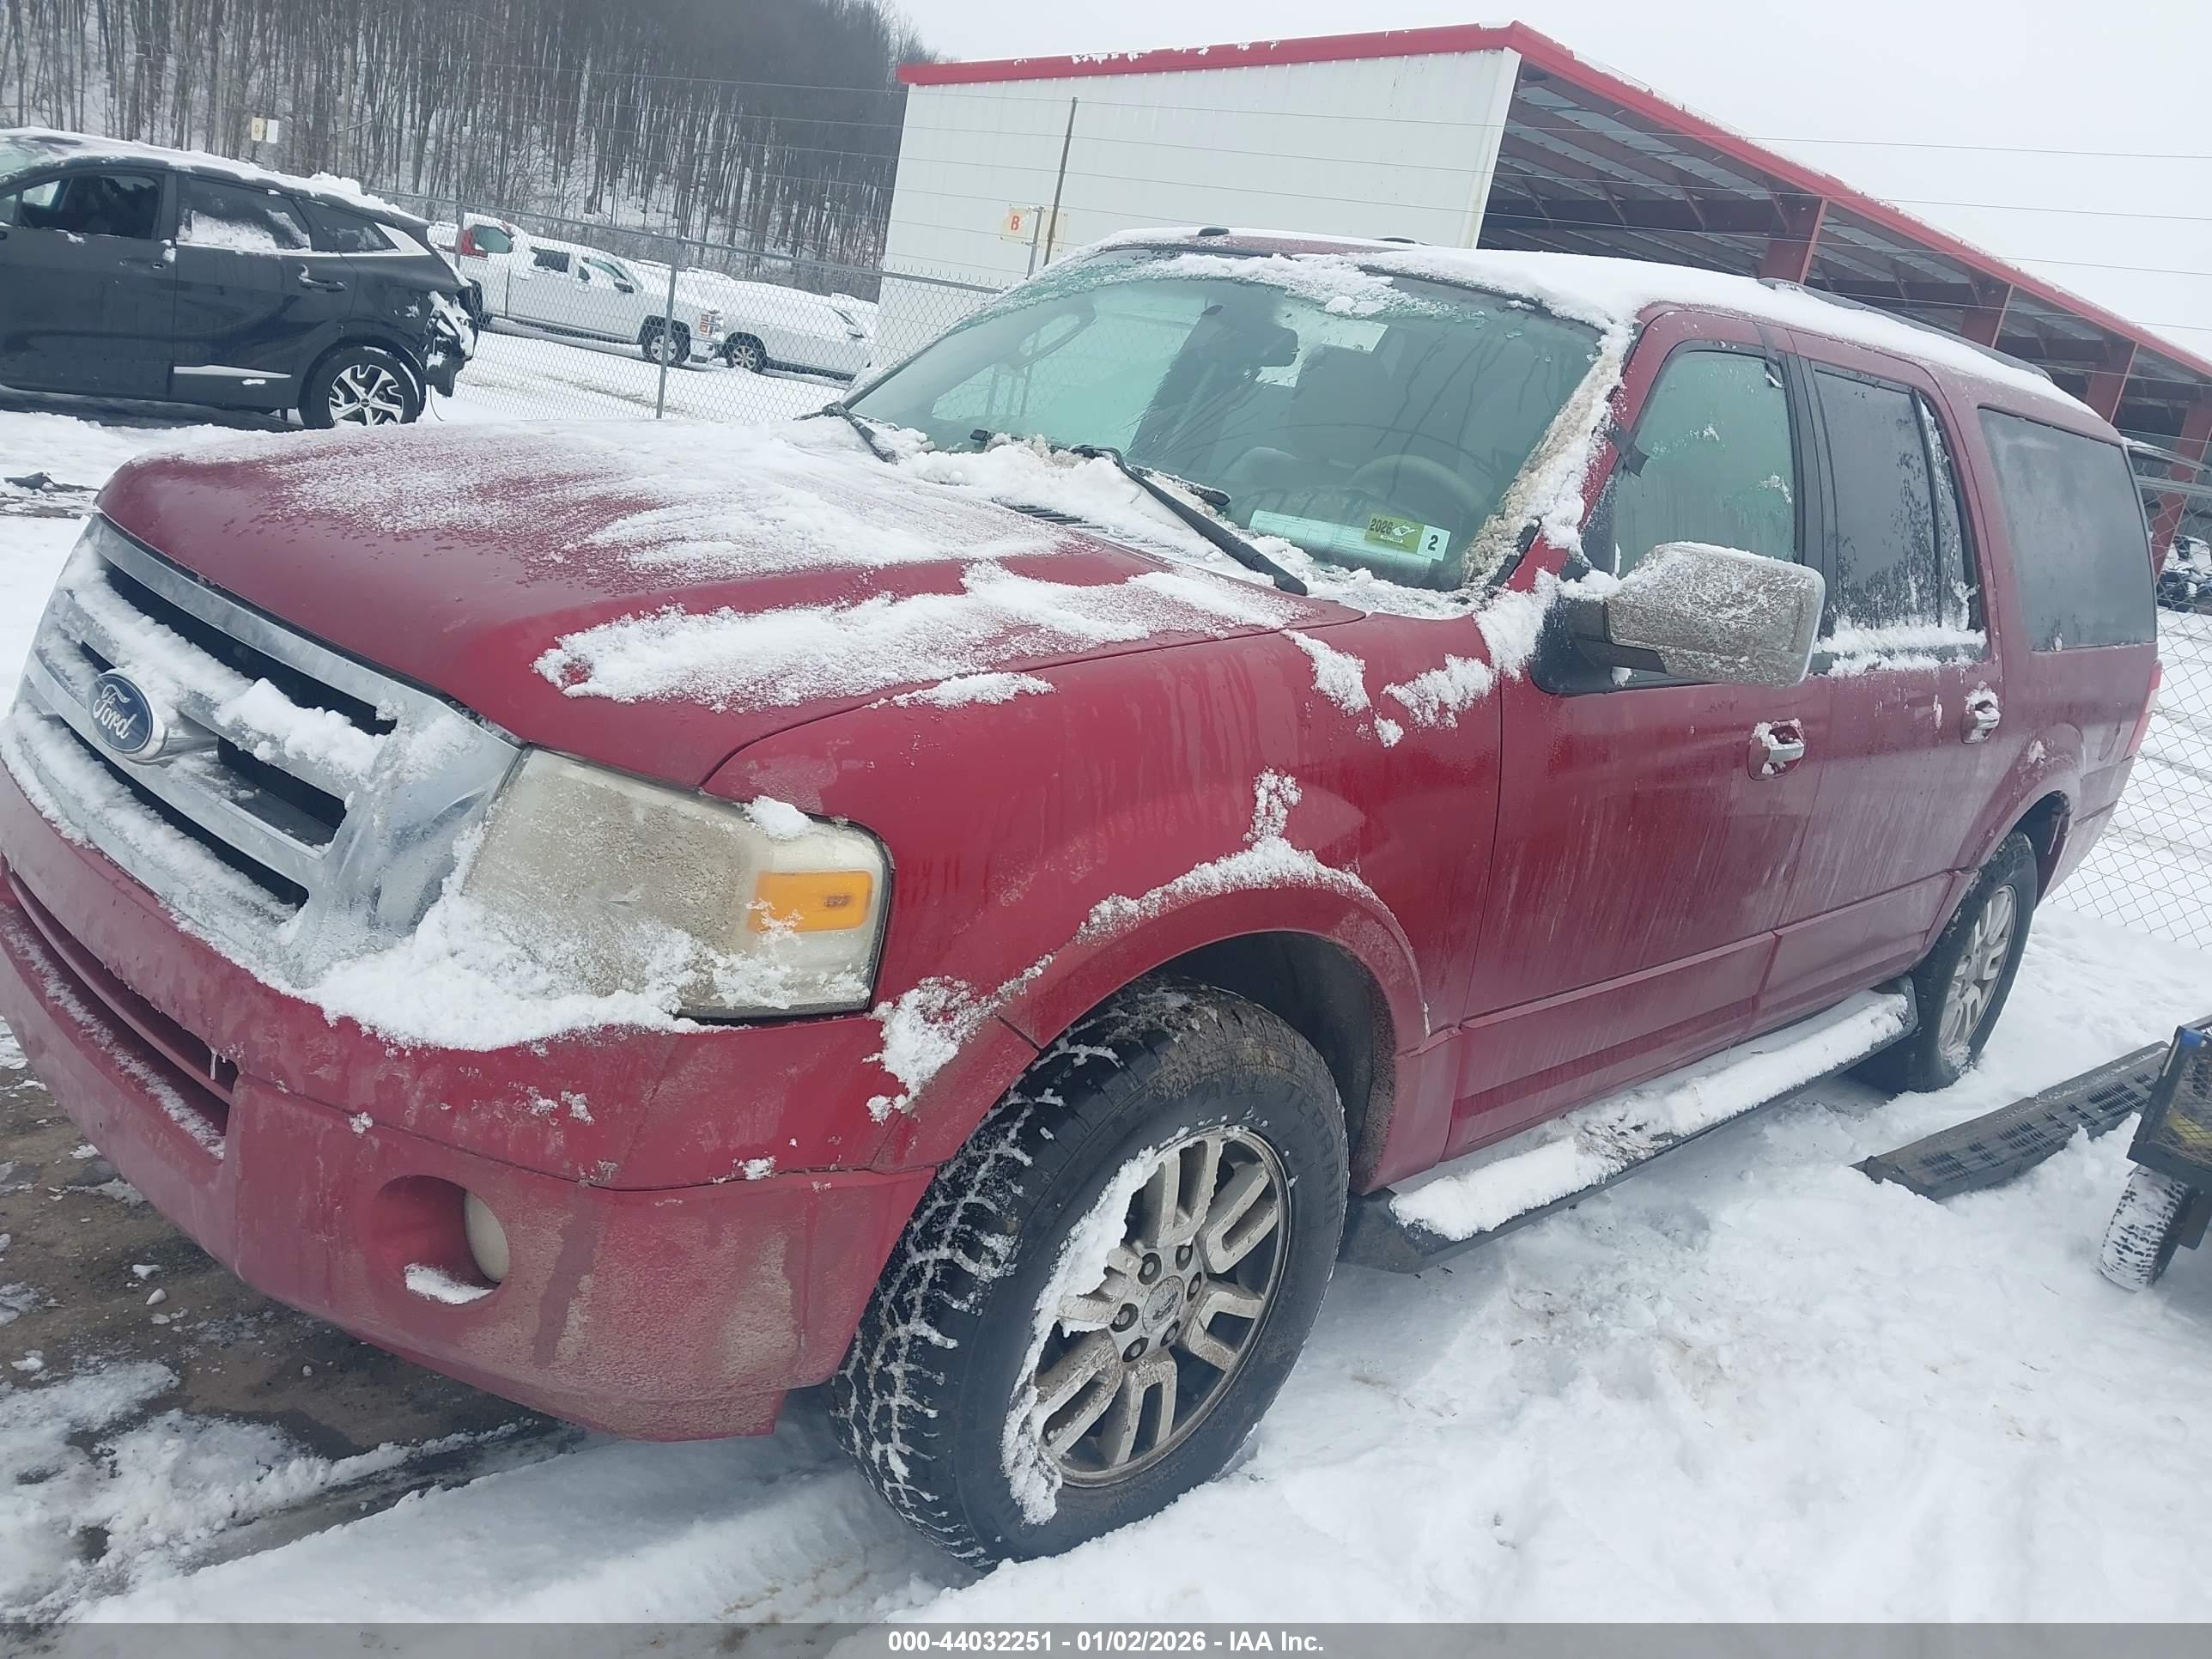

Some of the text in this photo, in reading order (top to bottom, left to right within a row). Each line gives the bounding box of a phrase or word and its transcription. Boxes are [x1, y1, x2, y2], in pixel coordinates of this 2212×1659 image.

[1011, 215, 1020, 231] B
[1369, 518, 1394, 534] 2026
[1427, 534, 1439, 551] 2
[92, 684, 137, 739] Ford
